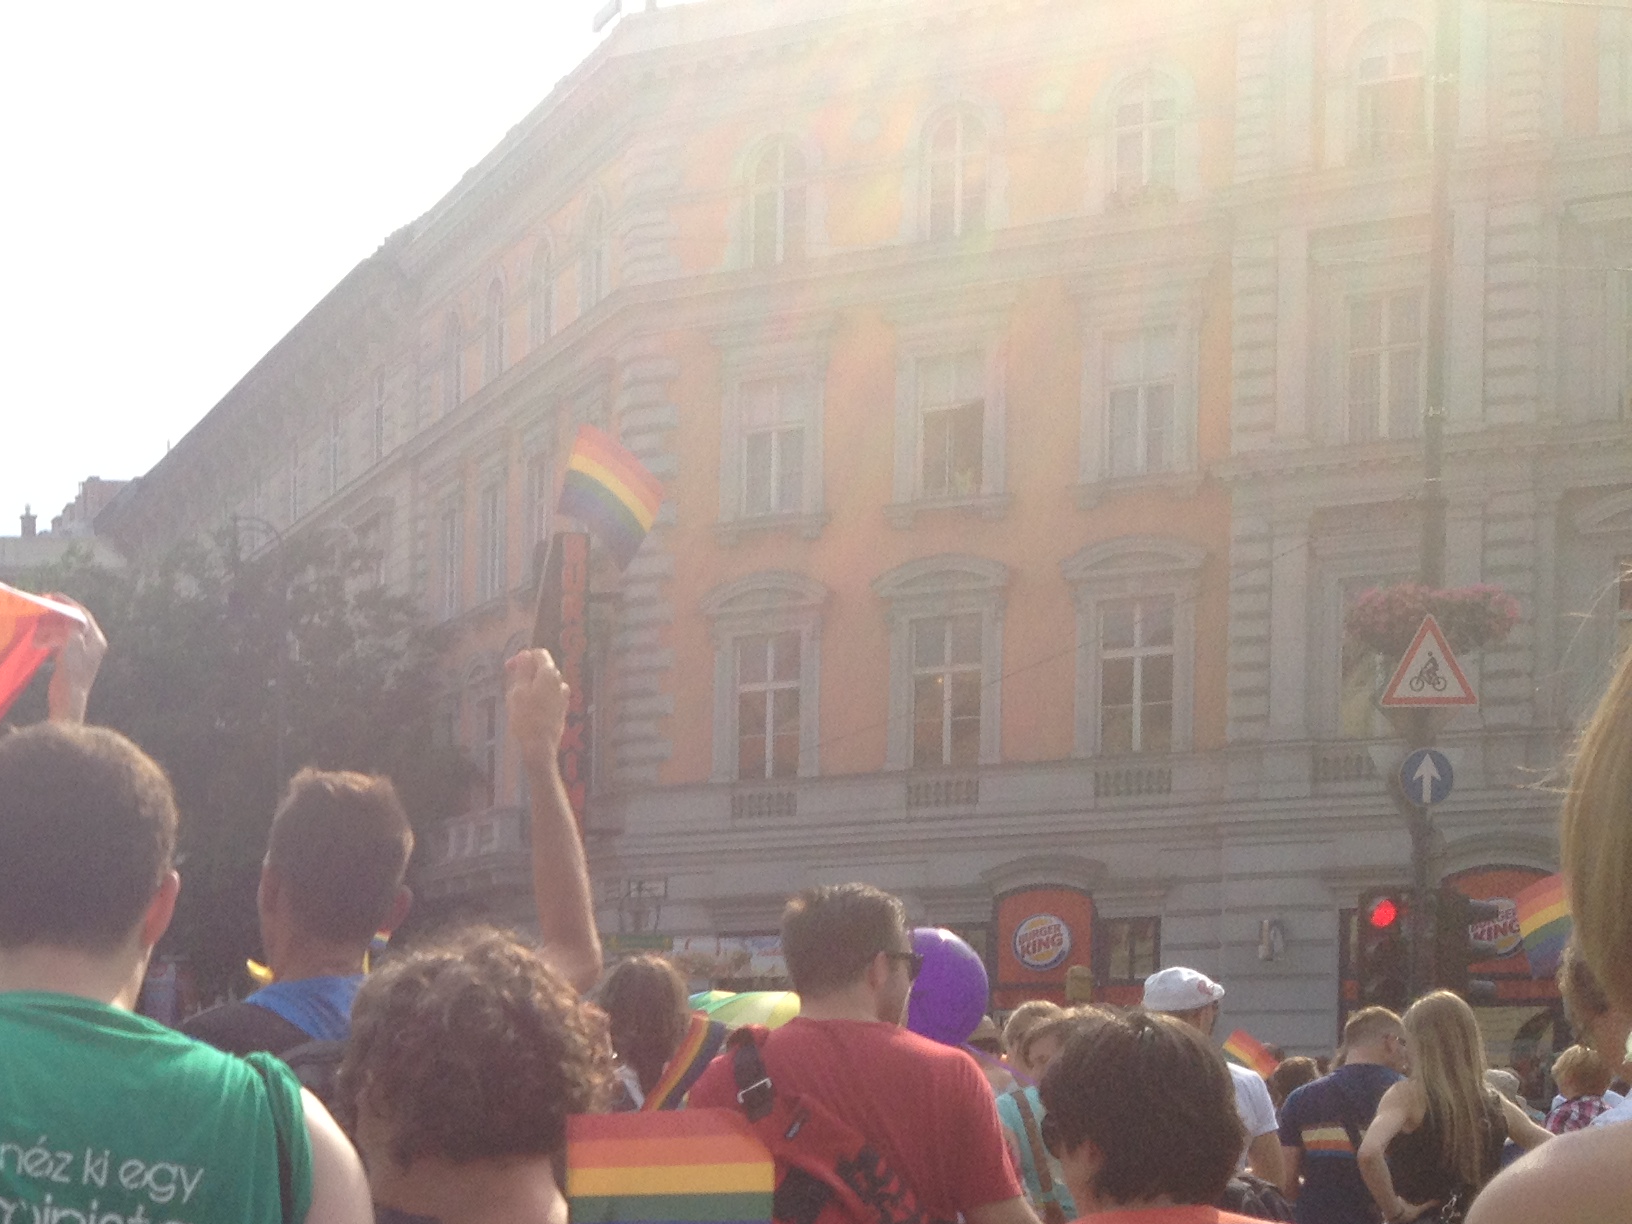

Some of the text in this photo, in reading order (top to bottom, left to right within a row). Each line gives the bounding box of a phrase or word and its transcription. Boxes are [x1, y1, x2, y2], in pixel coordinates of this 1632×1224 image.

[1018, 923, 1061, 946] BURGER
[1472, 920, 1521, 941] KING
[1020, 933, 1064, 959] KING
[82, 1147, 110, 1188] ki
[119, 1158, 204, 1204] egy
